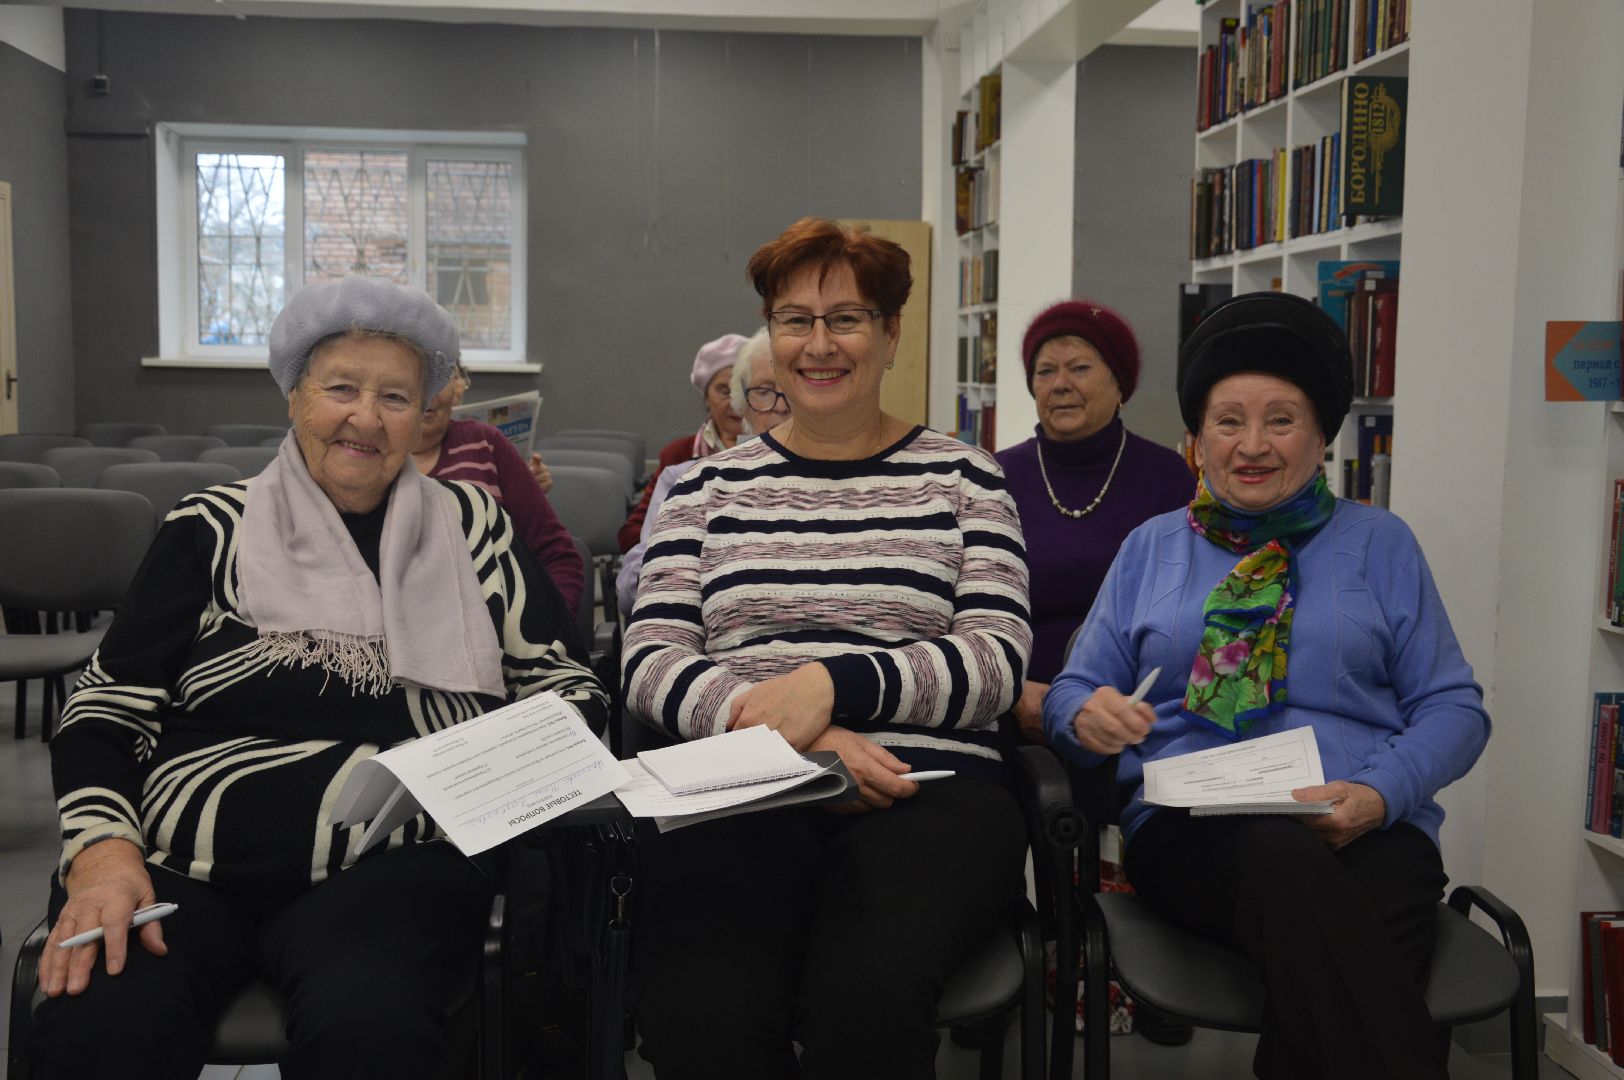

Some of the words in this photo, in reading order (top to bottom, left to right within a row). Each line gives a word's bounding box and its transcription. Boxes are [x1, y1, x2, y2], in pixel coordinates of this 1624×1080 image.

[1372, 101, 1385, 133] 1812
[1350, 82, 1369, 203] БОРОДИНО
[1573, 359, 1612, 373] период
[1589, 377, 1607, 388] 1917
[546, 789, 582, 810] ТЕСТОВЫЕ
[508, 806, 546, 827] ВОПРОСЫ
